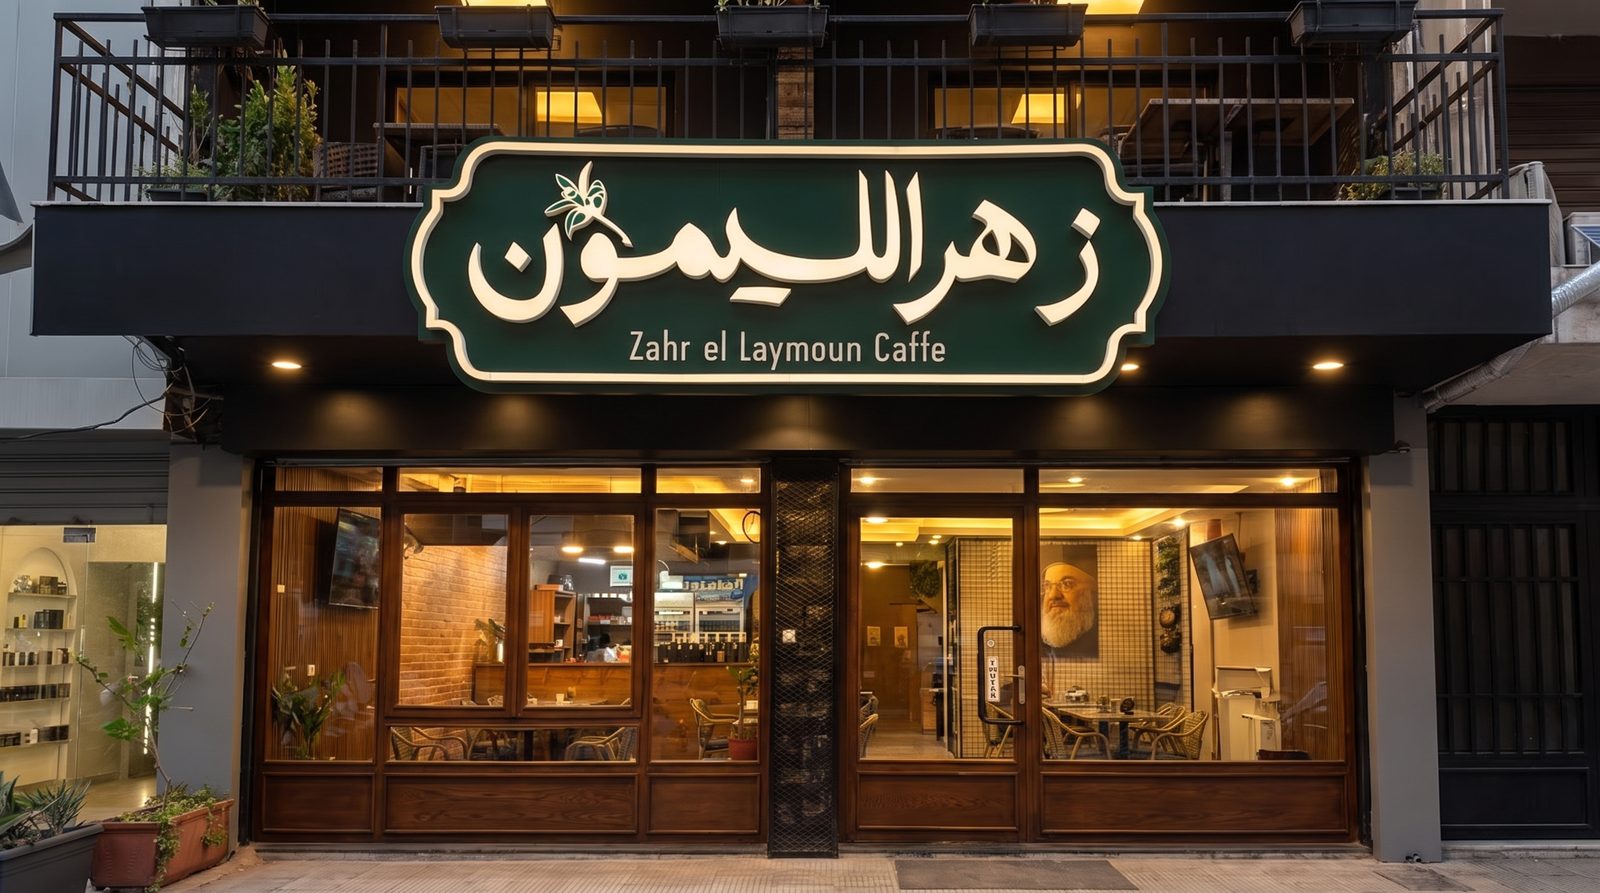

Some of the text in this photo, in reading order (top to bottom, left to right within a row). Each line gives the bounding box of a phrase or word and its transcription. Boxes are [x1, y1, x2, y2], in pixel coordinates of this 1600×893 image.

[467, 169, 1101, 328] زهر الليمون
[629, 329, 946, 369] Zahr el Laymoun Caffe
